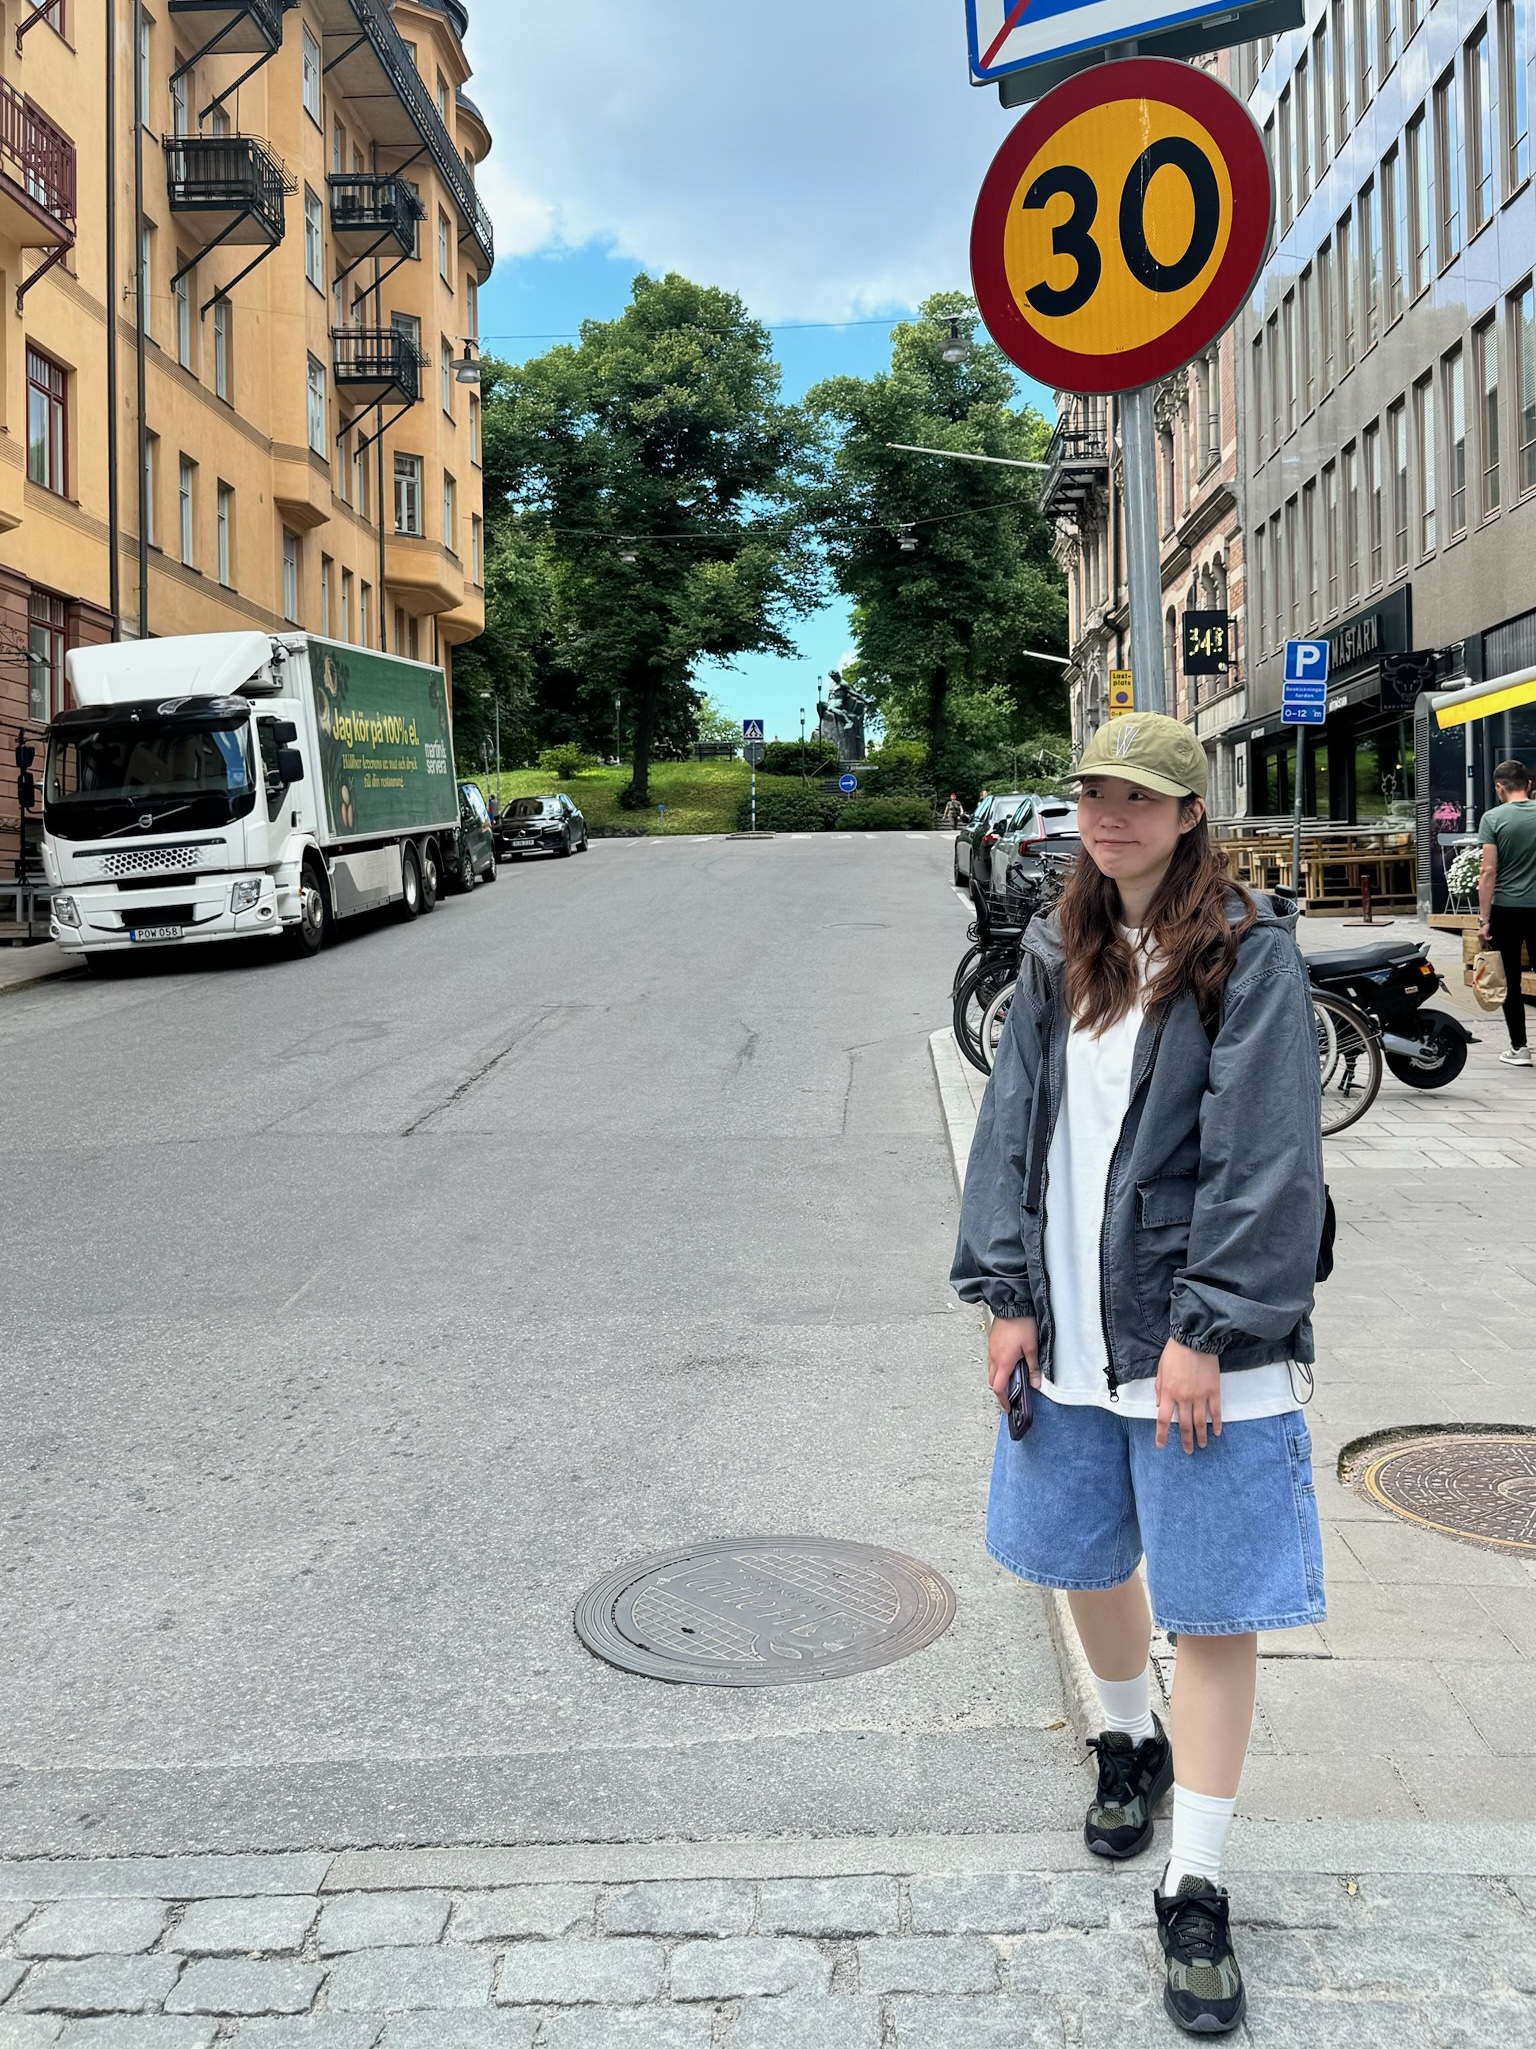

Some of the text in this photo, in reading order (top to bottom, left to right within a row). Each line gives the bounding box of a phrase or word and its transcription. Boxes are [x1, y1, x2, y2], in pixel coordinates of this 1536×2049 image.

[1021, 135, 1221, 318] 30
[1296, 644, 1321, 678] P
[332, 707, 353, 749] Jag
[352, 709, 369, 742] kör
[371, 711, 384, 750] på
[383, 714, 409, 746] 100%
[138, 927, 178, 938] POW 058
